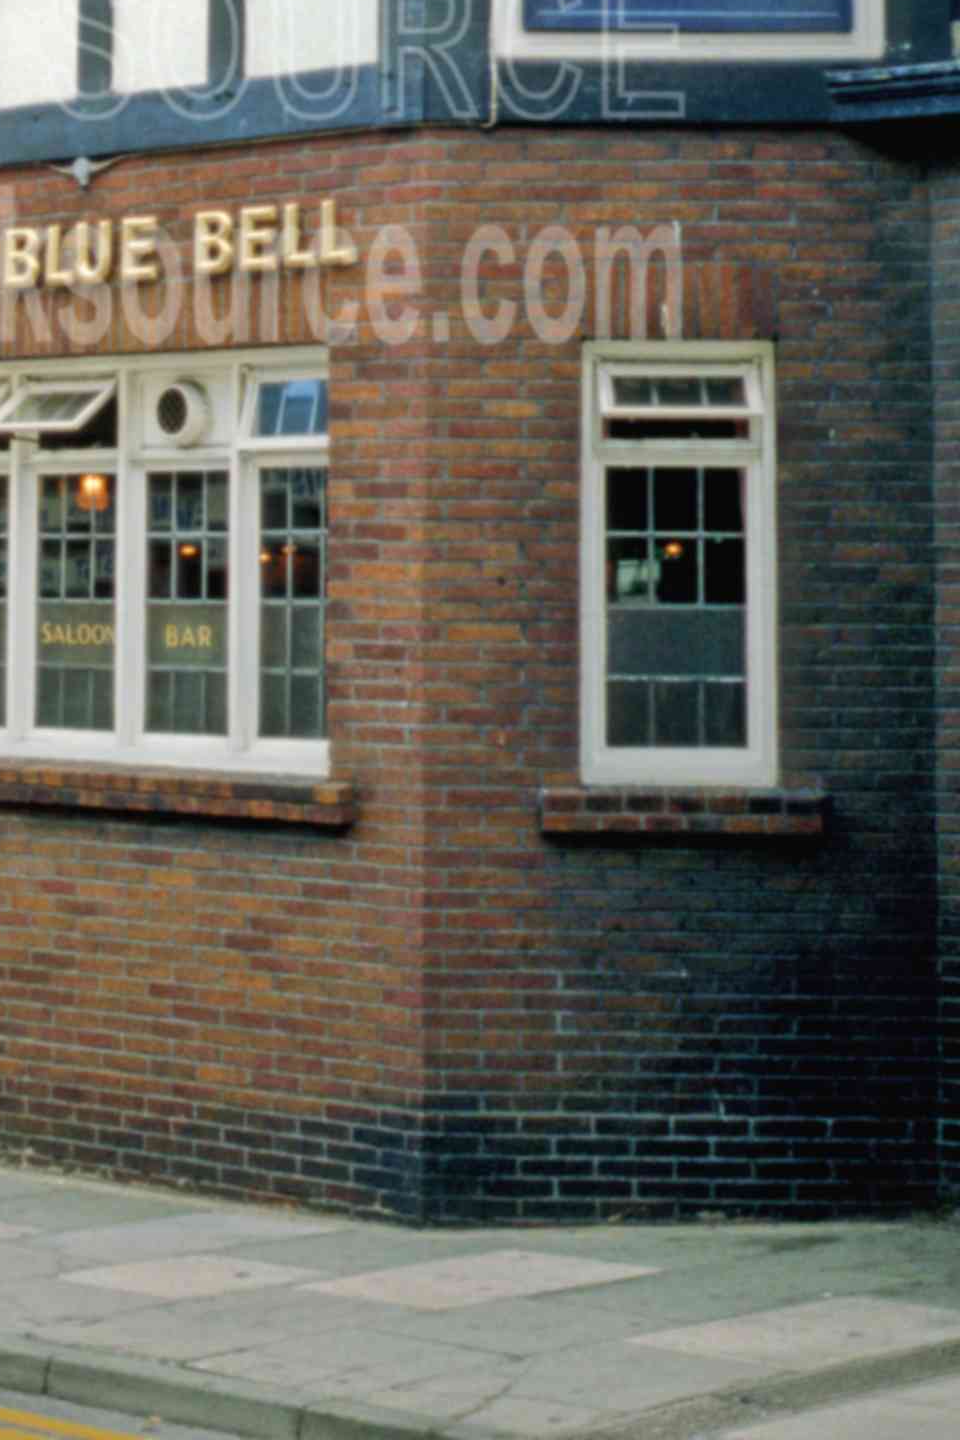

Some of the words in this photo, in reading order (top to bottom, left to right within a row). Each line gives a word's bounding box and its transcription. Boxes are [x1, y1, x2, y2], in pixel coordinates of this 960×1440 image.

[4, 215, 160, 289] BLUE
[194, 199, 358, 276] BELL
[165, 623, 215, 649] BAR
